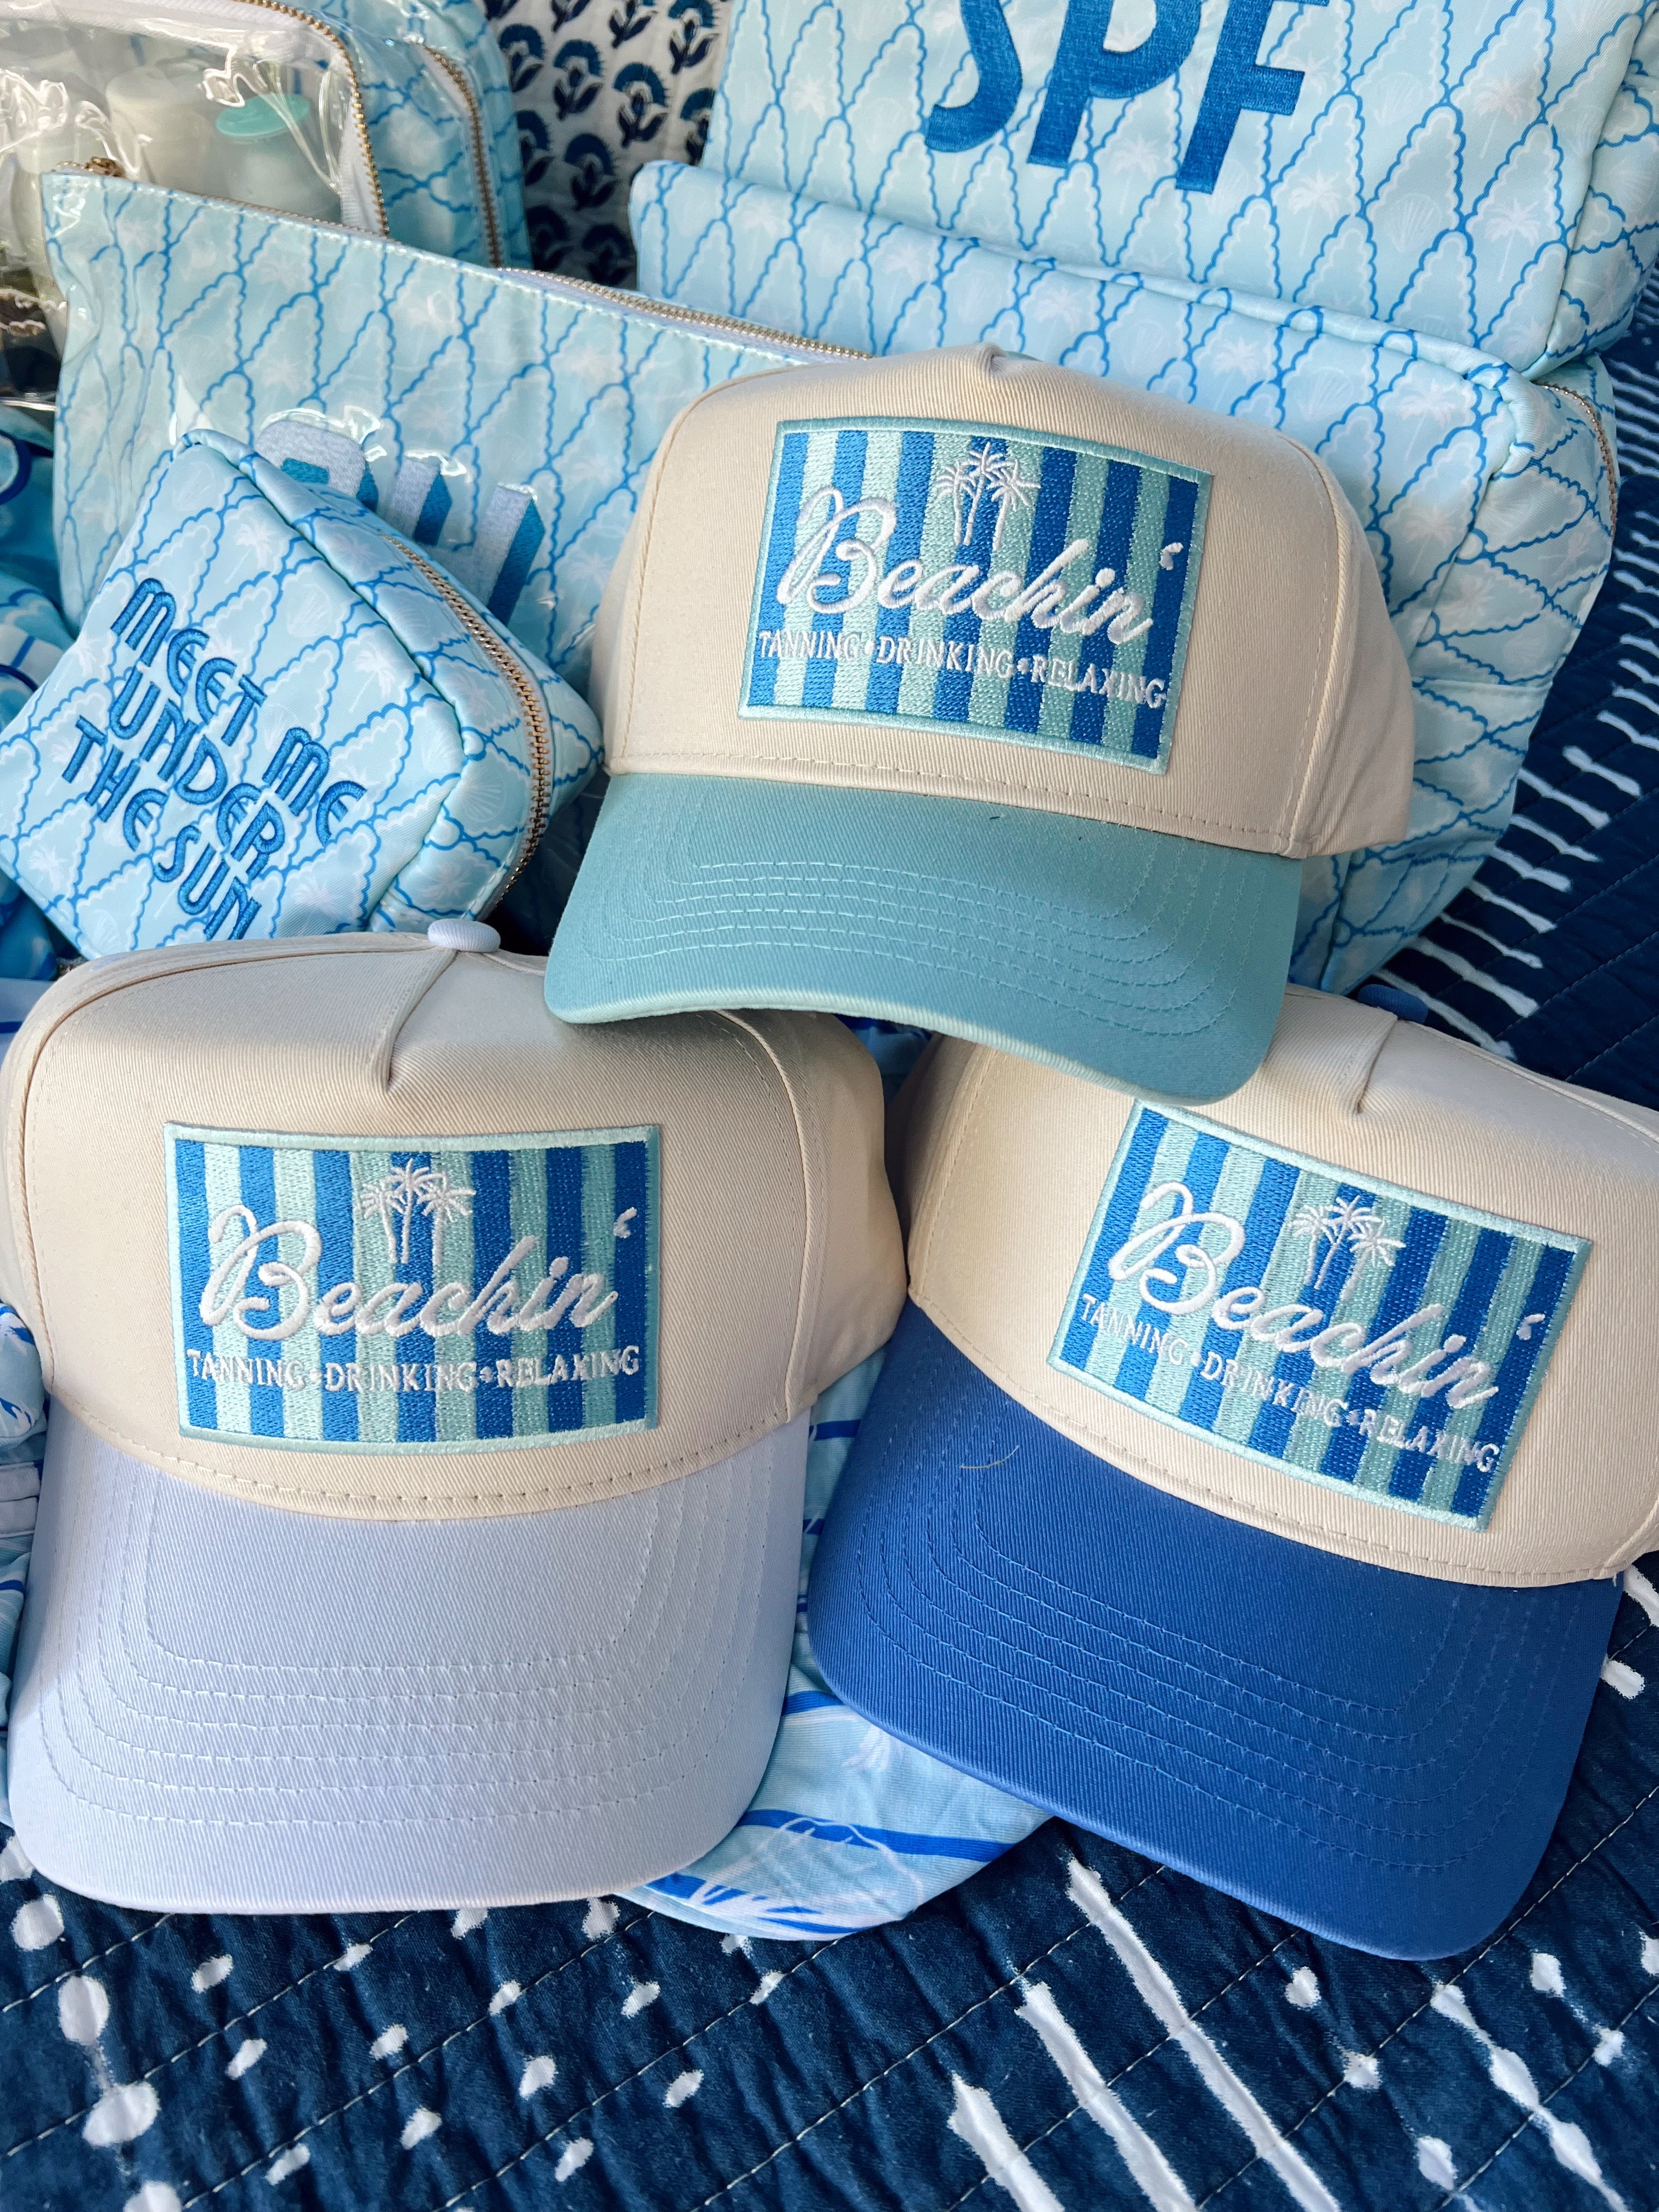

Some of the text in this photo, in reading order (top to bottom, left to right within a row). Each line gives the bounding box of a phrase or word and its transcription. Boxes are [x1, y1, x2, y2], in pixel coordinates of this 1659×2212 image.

[926, 0, 1328, 194] SPF
[110, 578, 368, 847] MEET ME
[110, 670, 286, 876] UNDER
[61, 715, 262, 940] THE SUN
